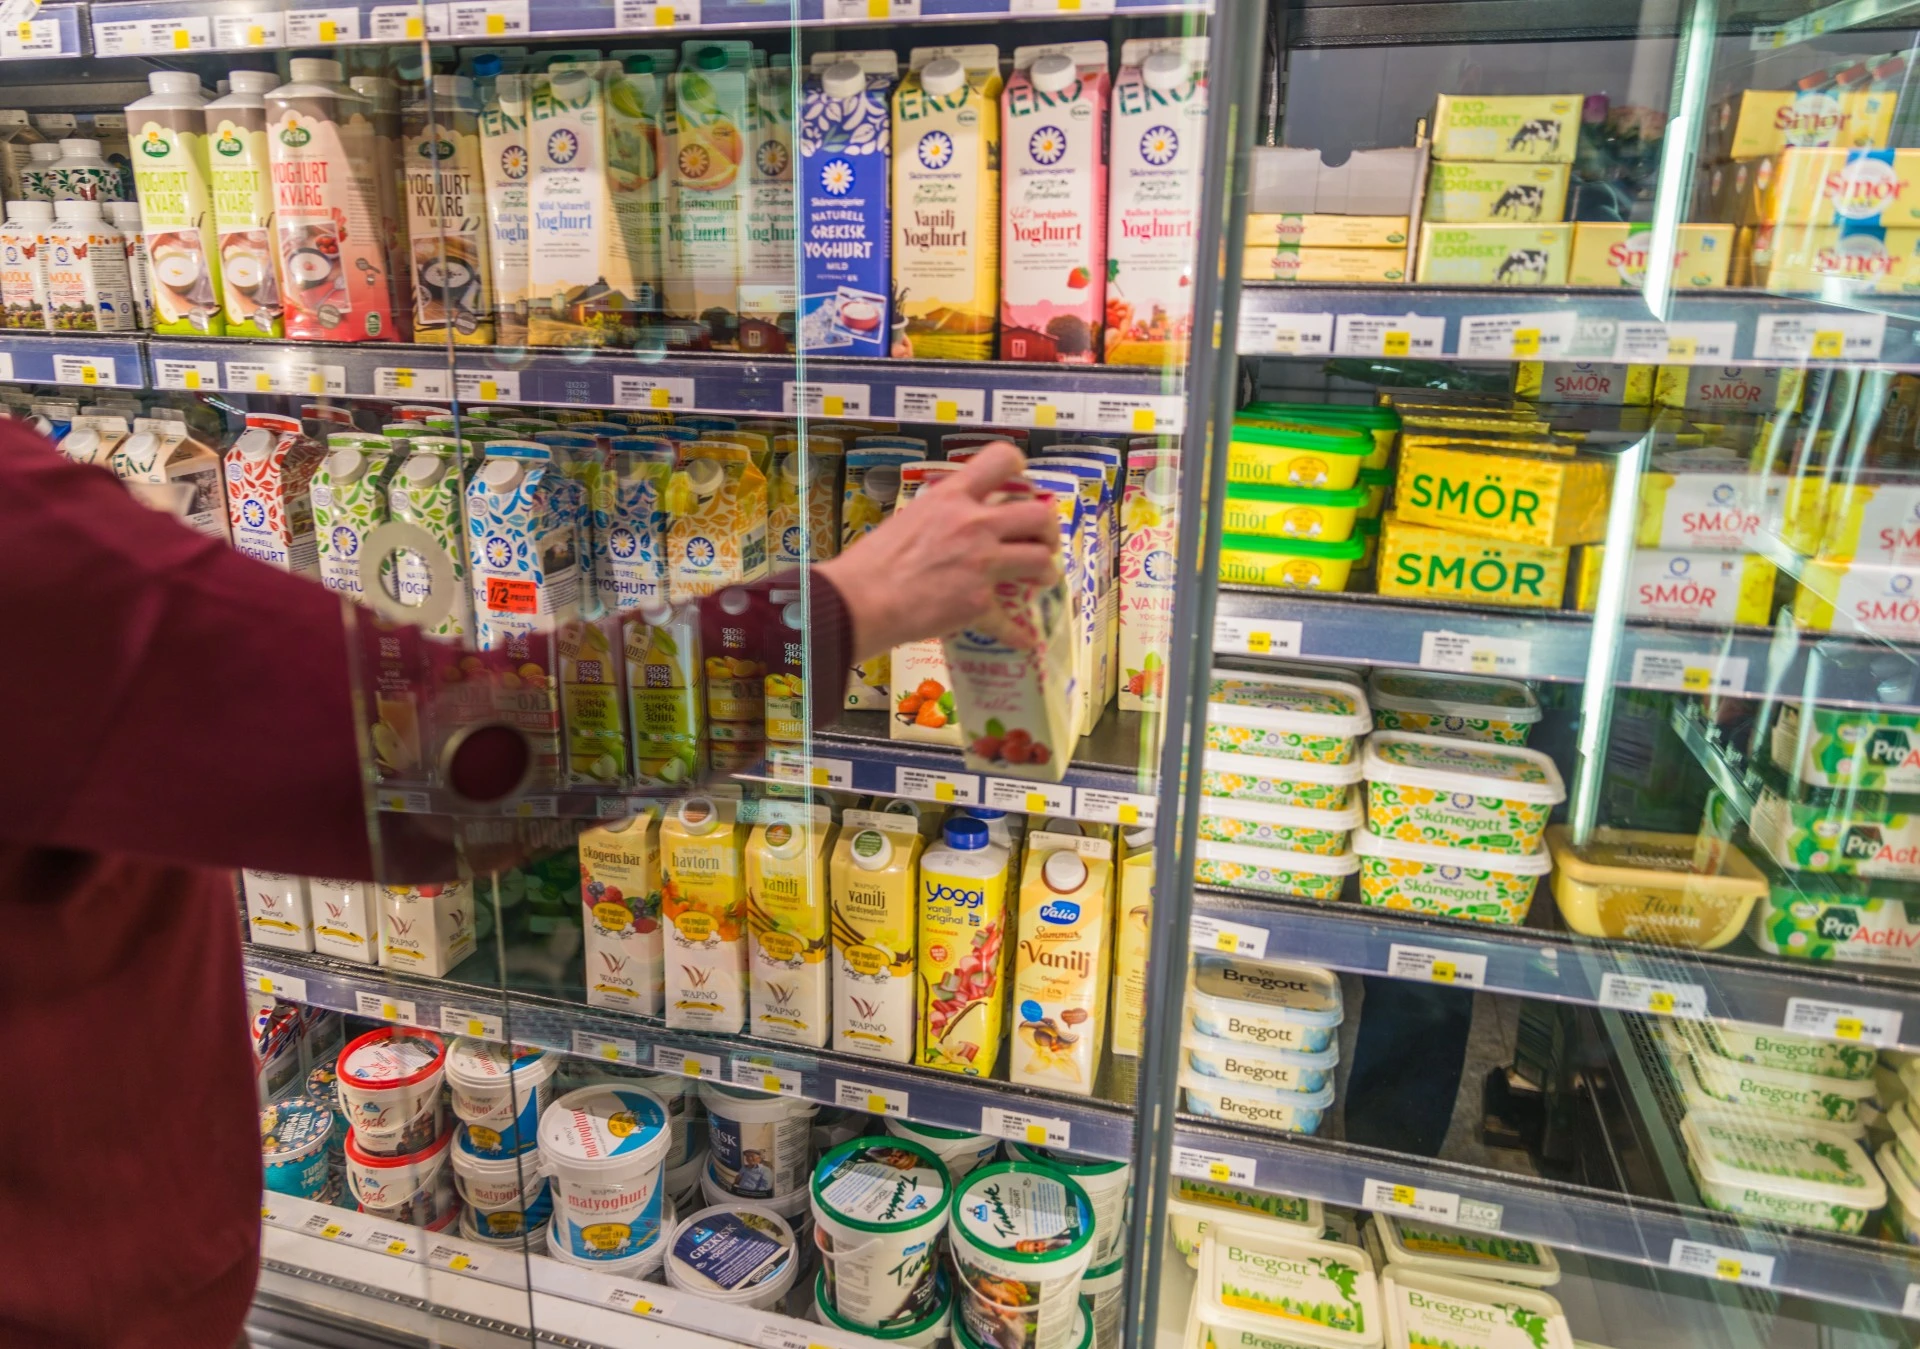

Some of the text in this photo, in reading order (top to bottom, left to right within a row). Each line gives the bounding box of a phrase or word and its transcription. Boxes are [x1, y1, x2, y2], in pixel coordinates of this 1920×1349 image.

[1450, 115, 1521, 127] LOGISKT
[1774, 105, 1853, 132] Smör
[281, 130, 310, 145] Arla
[138, 171, 188, 193] YOGHURT
[212, 171, 259, 192] YOGHURT
[272, 162, 328, 184] YOGHURT
[407, 174, 470, 195] YOGHURT
[1434, 181, 1504, 192] LOGISKT
[1822, 170, 1909, 202] Smör
[145, 194, 185, 213] KVARG
[280, 185, 322, 206] KVARG
[417, 196, 463, 217] KVARG
[811, 210, 865, 222] NATURELL
[536, 211, 592, 232] Yoghurt
[914, 210, 955, 229] Vanilj
[1275, 223, 1306, 234] Smör
[494, 223, 528, 244] Yogh
[746, 223, 796, 245] Yoghur
[811, 225, 866, 239] GREKISK
[903, 229, 967, 252] Yoghurt
[1013, 221, 1081, 247] Yoghurt
[1121, 218, 1192, 244] Yoghurt
[804, 242, 873, 259] YOGHURT
[1433, 245, 1506, 258] LOGISKT
[1606, 243, 1688, 269] Smr
[1815, 247, 1901, 274] Smör
[826, 262, 849, 271] MILD
[1271, 258, 1303, 269] Smör
[1555, 376, 1611, 394] SMÖR
[1700, 378, 1761, 400] SMÖR
[1231, 460, 1273, 479] mör
[1410, 473, 1540, 527] SMÖR
[1228, 508, 1268, 530] mör
[1682, 508, 1761, 536] SMÖR
[240, 536, 274, 549] NATURELL
[1880, 528, 1920, 550] SM
[329, 567, 360, 577] NATURE
[604, 570, 644, 581] NATURELL
[1395, 550, 1546, 597] SMÖR
[323, 575, 364, 593] YOGHU
[399, 581, 432, 596] YOGH
[489, 585, 509, 604] 1/2
[597, 579, 657, 596] YOGHURT
[676, 582, 716, 597] VANIL
[1639, 580, 1717, 609] SMÖR
[1130, 597, 1172, 610] VANI
[1856, 598, 1920, 623] SMÖ
[1413, 753, 1509, 773] Skånegott
[1872, 739, 1920, 769] ProA
[1413, 806, 1502, 832] Skånegott
[583, 847, 641, 866] skogens bär
[672, 852, 720, 870] havtorn
[762, 878, 798, 896] vanilj
[926, 881, 984, 909] yoggi
[1403, 878, 1490, 902] Skånegott
[848, 889, 886, 910] vanilj
[926, 904, 953, 915] vanilj
[926, 913, 964, 925] original
[1040, 904, 1077, 921] Valio
[387, 935, 420, 949] WAPNÖ
[1035, 926, 1082, 942] Sommar
[1823, 916, 1920, 949] ProActiv
[1020, 940, 1092, 979] Vanilj
[599, 973, 634, 987] WAPNÖ
[1223, 967, 1309, 992] Bregott
[681, 989, 718, 1000] WAPNÖ
[765, 1003, 801, 1018] WAPNÖ
[849, 1019, 887, 1032] WAPNÖ
[1228, 1017, 1292, 1042] Bregott
[1755, 1036, 1825, 1062] Bregott
[1225, 1058, 1288, 1082] Bregott
[1739, 1077, 1810, 1106] Bregott
[1220, 1096, 1283, 1121] Bregott
[570, 1106, 599, 1158] matyoghurt
[302, 1162, 328, 1178] TURK
[568, 1185, 648, 1211] matyoghurt
[1743, 1188, 1817, 1216] Bregott
[708, 1237, 740, 1262] YOGHURT
[1228, 1246, 1311, 1276] Bregott
[1409, 1291, 1498, 1324] Bregott
[1241, 1331, 1306, 1349] Brego
